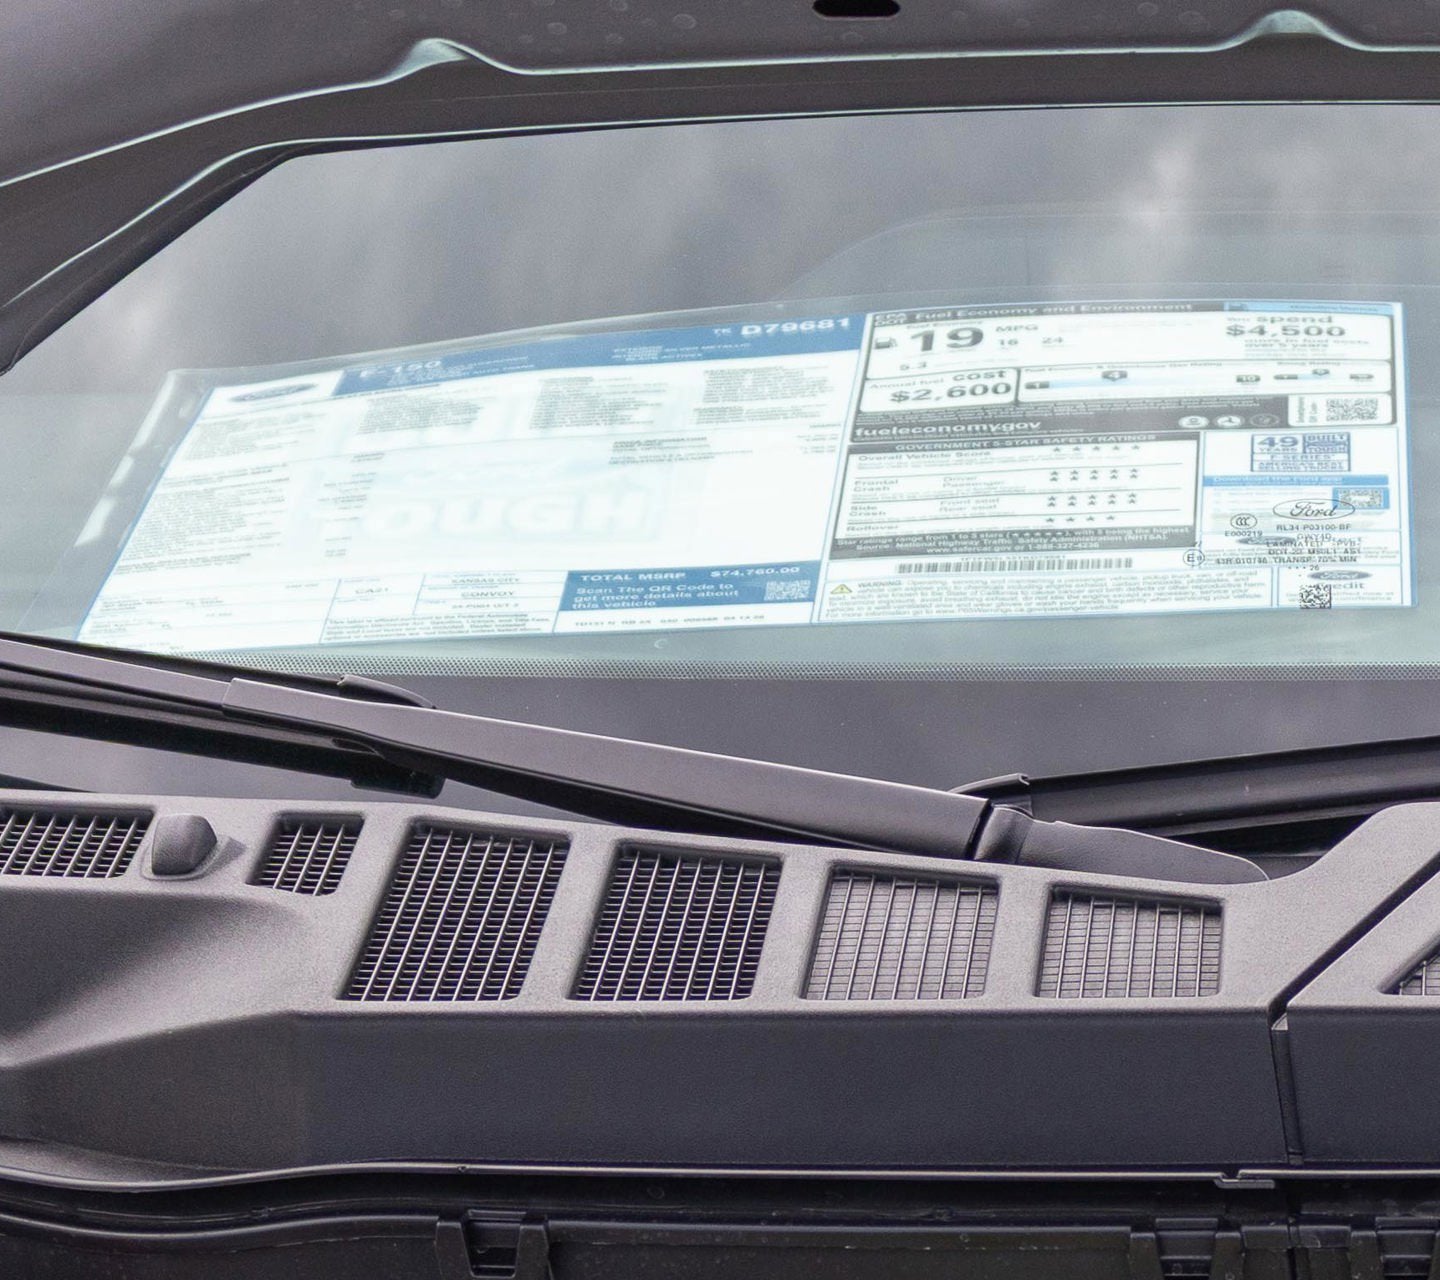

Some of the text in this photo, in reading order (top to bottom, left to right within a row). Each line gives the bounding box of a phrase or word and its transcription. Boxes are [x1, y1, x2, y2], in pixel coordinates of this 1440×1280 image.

[916, 311, 952, 320] Fuel
[957, 307, 1038, 319] Economy
[1043, 304, 1075, 313] and
[1080, 303, 1192, 313] Environment
[740, 317, 850, 336] D79681
[1256, 315, 1333, 325] spend
[910, 323, 1040, 352] 19 MPG
[1225, 323, 1347, 338] $4,500
[1042, 335, 1064, 345] 24
[870, 369, 1007, 390] Annual fuel cost
[889, 382, 1012, 404] $2,600
[855, 421, 1042, 438] fueleconomy.gov
[895, 441, 990, 452] GOVERNMENT
[993, 437, 1039, 448] 5-STAR
[1043, 436, 1096, 445] SAFETY
[1097, 433, 1158, 443] RATINGS
[1257, 434, 1347, 448] 49 BUILT
[858, 450, 992, 462] Overall Vehicle Score
[580, 573, 633, 582] TOTAL
[638, 571, 687, 581] MSRP
[573, 588, 740, 604] get more details about
[575, 582, 735, 595] Scan The QR Code to
[572, 599, 658, 610] this vehicle
